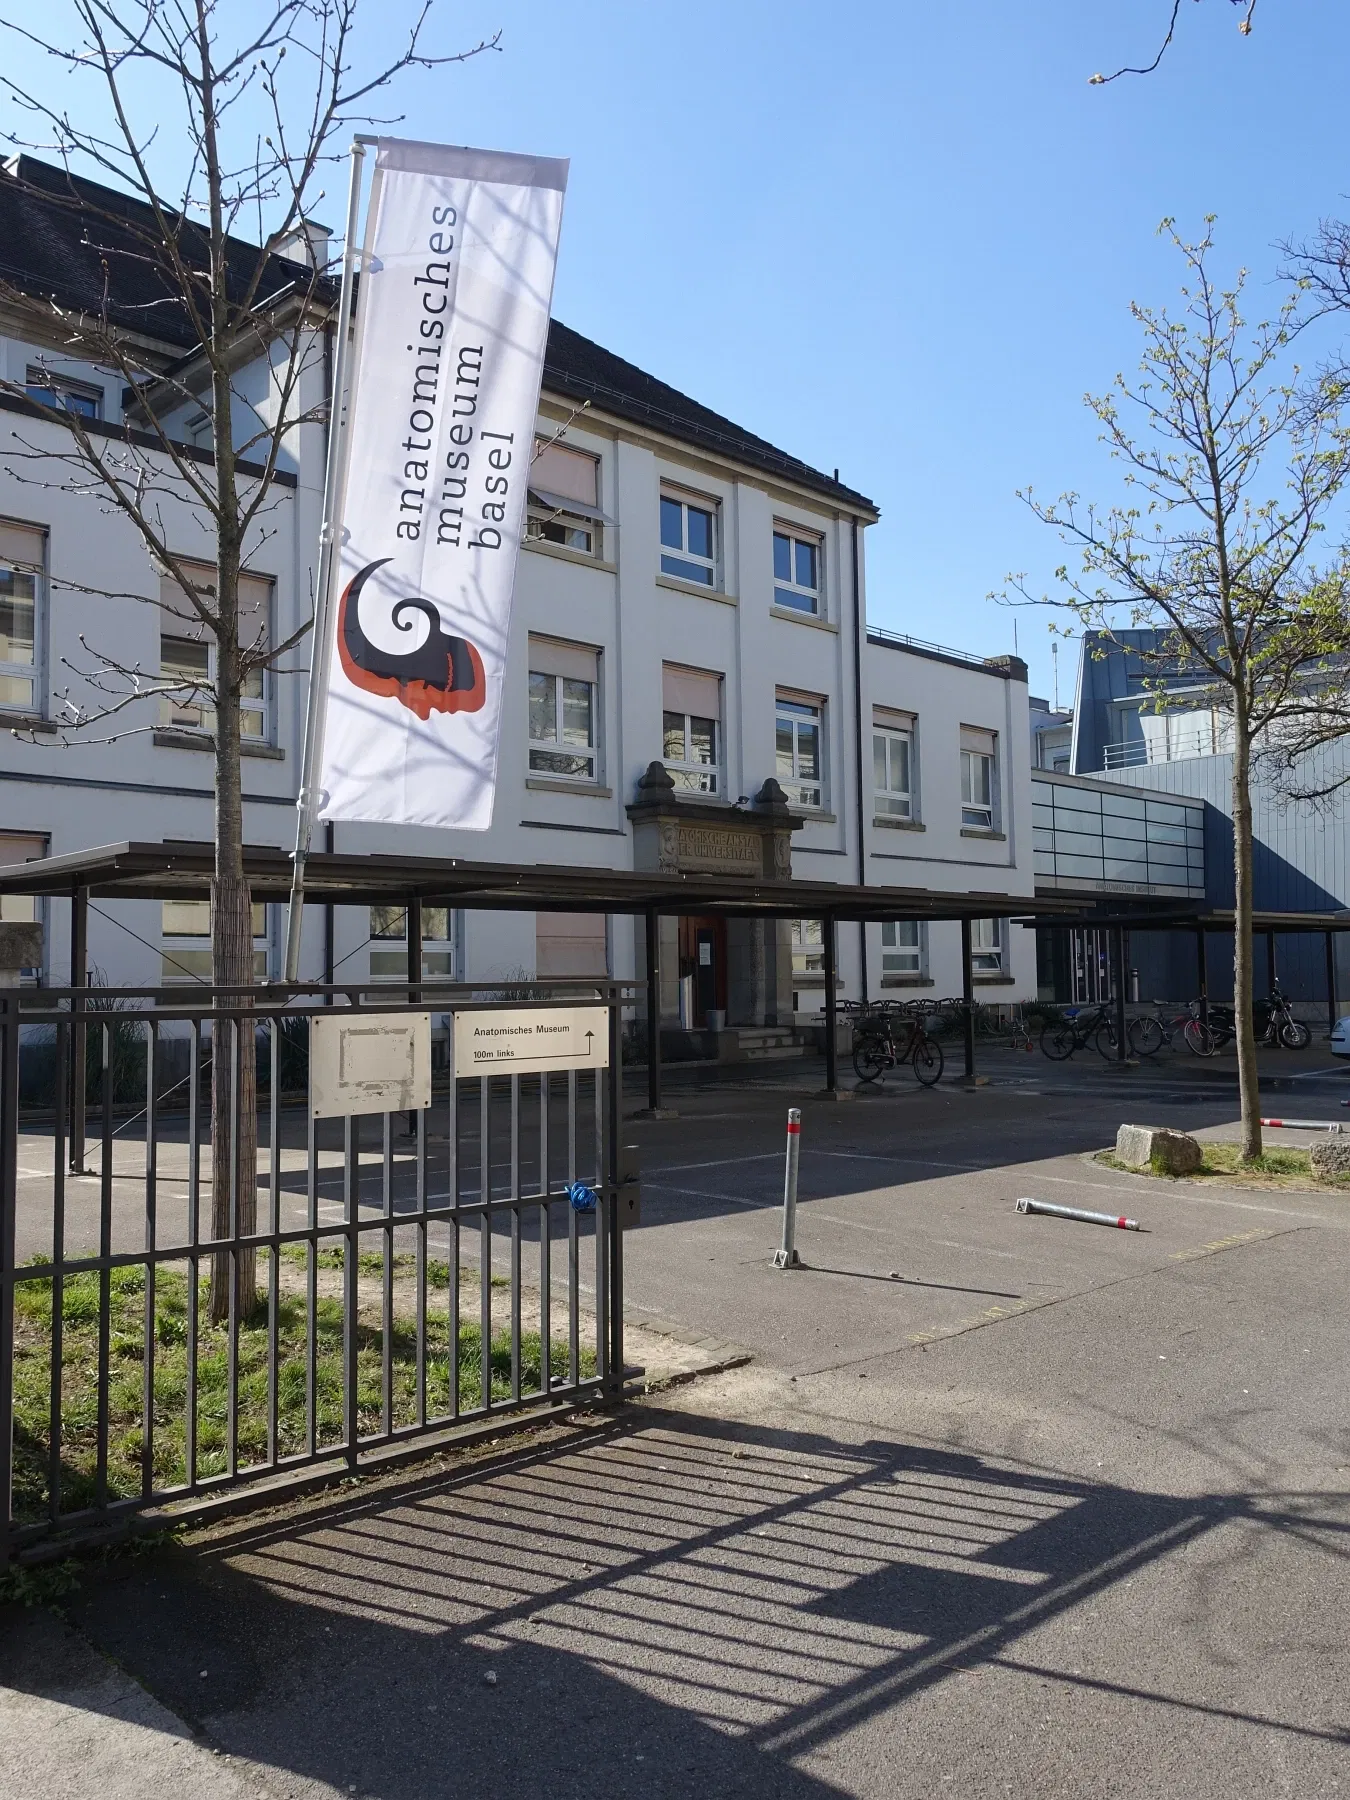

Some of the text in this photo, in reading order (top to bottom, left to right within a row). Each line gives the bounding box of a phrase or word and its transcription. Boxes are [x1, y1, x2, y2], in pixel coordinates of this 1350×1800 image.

[396, 206, 457, 541] anatomisches
[436, 346, 483, 547] museum
[467, 432, 514, 550] basel
[473, 1024, 570, 1037] Anatomisches Museum
[473, 1049, 515, 1059] 100m links
